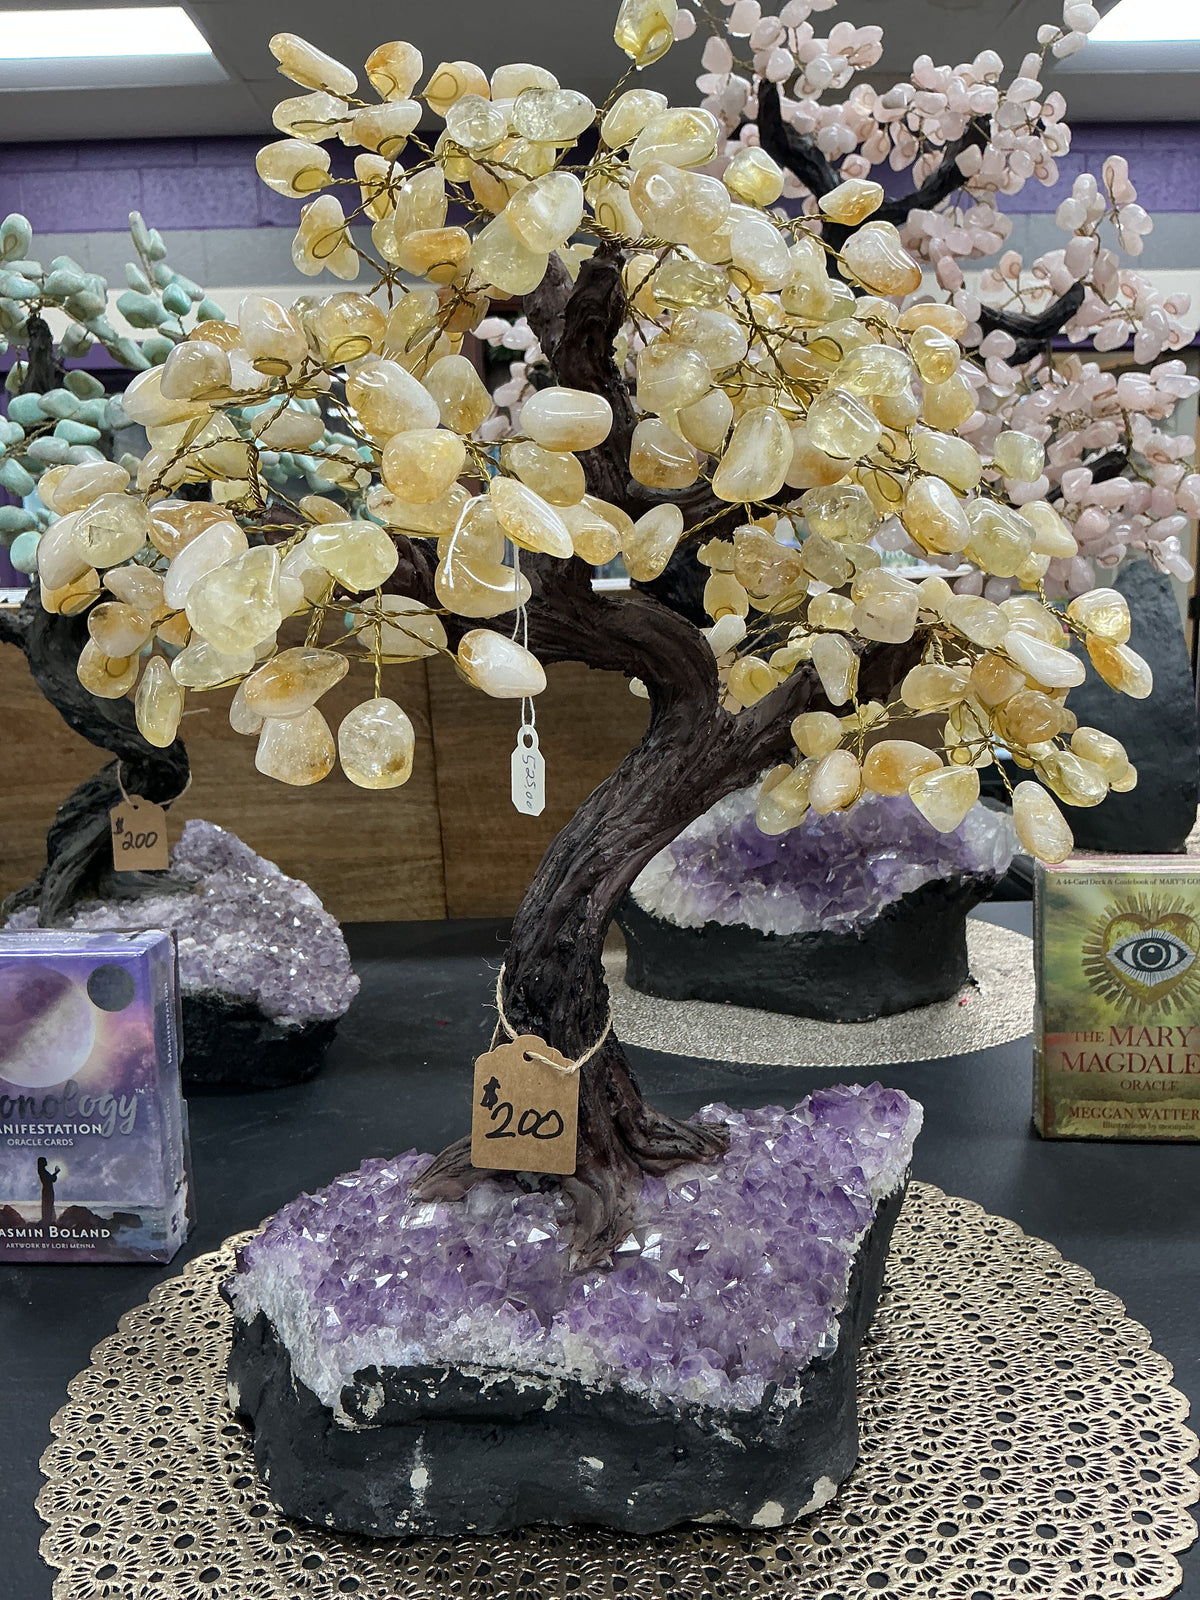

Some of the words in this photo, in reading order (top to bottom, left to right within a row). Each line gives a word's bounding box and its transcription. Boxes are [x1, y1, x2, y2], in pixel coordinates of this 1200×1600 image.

[1071, 1031, 1104, 1043] THE
[1109, 1025, 1195, 1048] MARY
[1061, 1051, 1200, 1074] MAGDALE
[1120, 1080, 1179, 1091] ORACLE
[480, 1076, 564, 1139] $200
[1069, 1106, 1133, 1119] MEGGAN
[0, 1124, 101, 1134] NIFESTATION
[7, 1138, 41, 1146] ORACLE
[44, 1138, 74, 1146] CARDS
